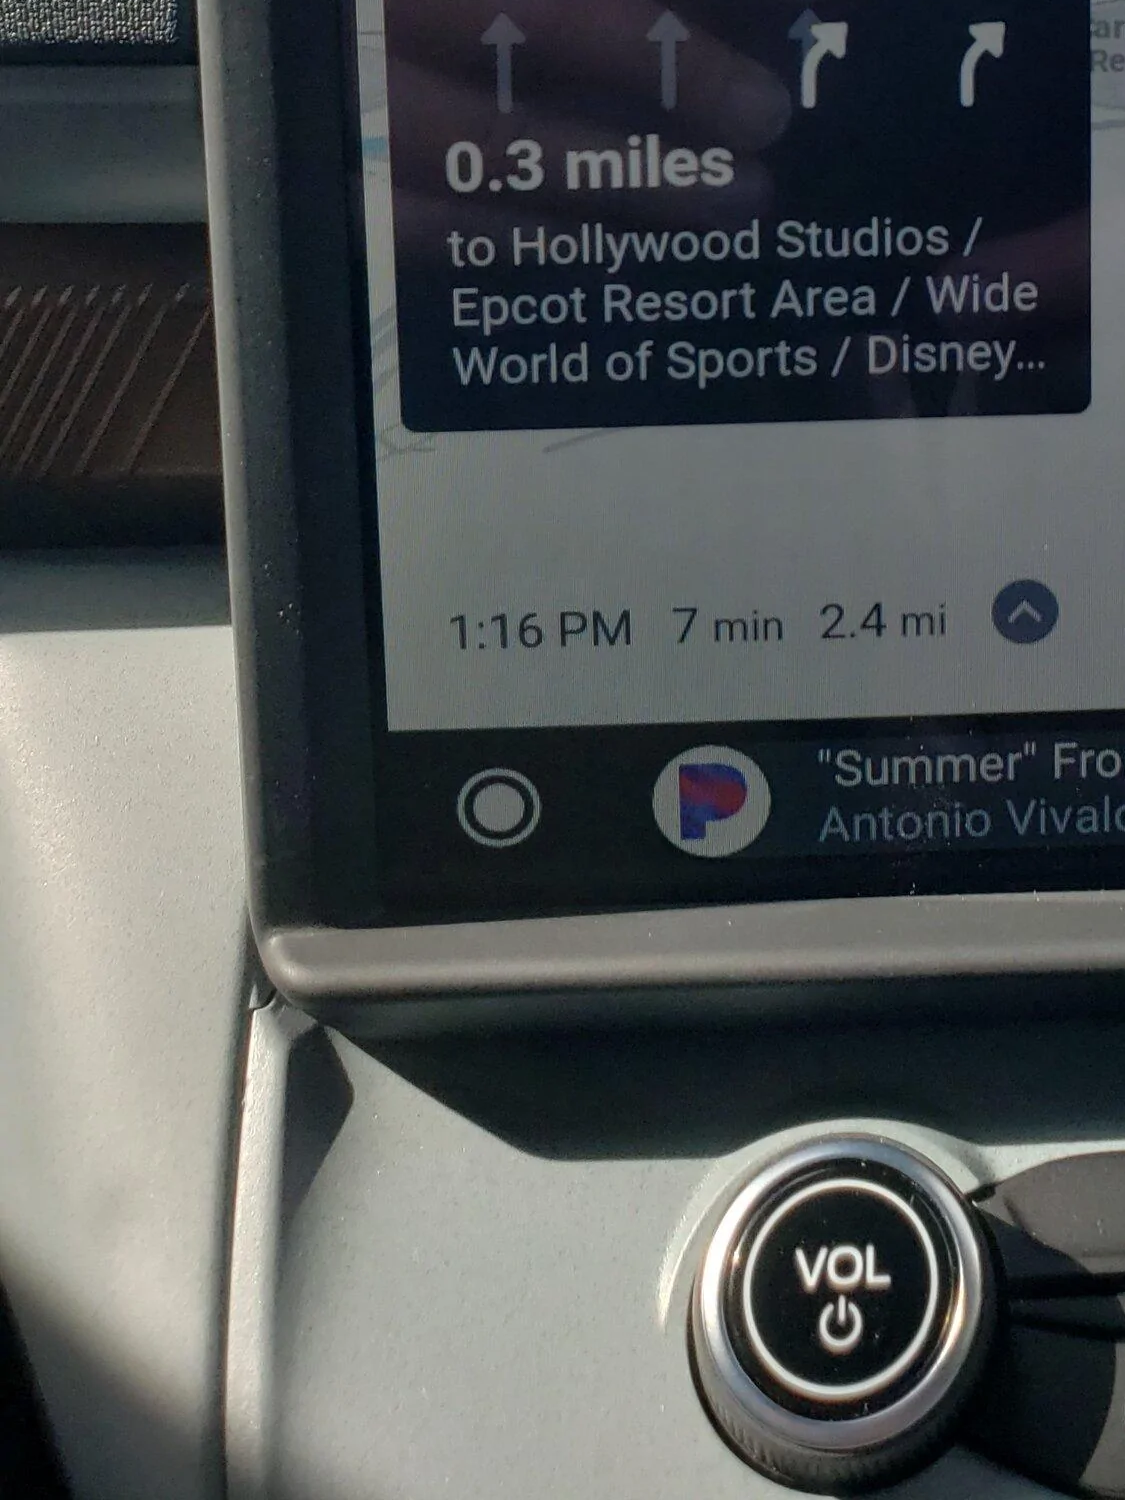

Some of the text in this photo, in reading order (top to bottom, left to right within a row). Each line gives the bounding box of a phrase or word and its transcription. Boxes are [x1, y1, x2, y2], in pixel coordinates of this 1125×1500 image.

[445, 134, 736, 194] 0.3 miles
[447, 216, 984, 274] to Hollywood Studios /
[453, 272, 1039, 337] Epcot Resort Area / Wide
[453, 343, 590, 387] World
[606, 340, 654, 382] of
[667, 338, 818, 389] Sports
[831, 336, 852, 379] /
[450, 602, 948, 650] 1:16 PM 7 min 2.4 mi
[818, 741, 1037, 788] "Summer"
[818, 802, 991, 843] Antonio
[795, 1244, 892, 1294] VOL
